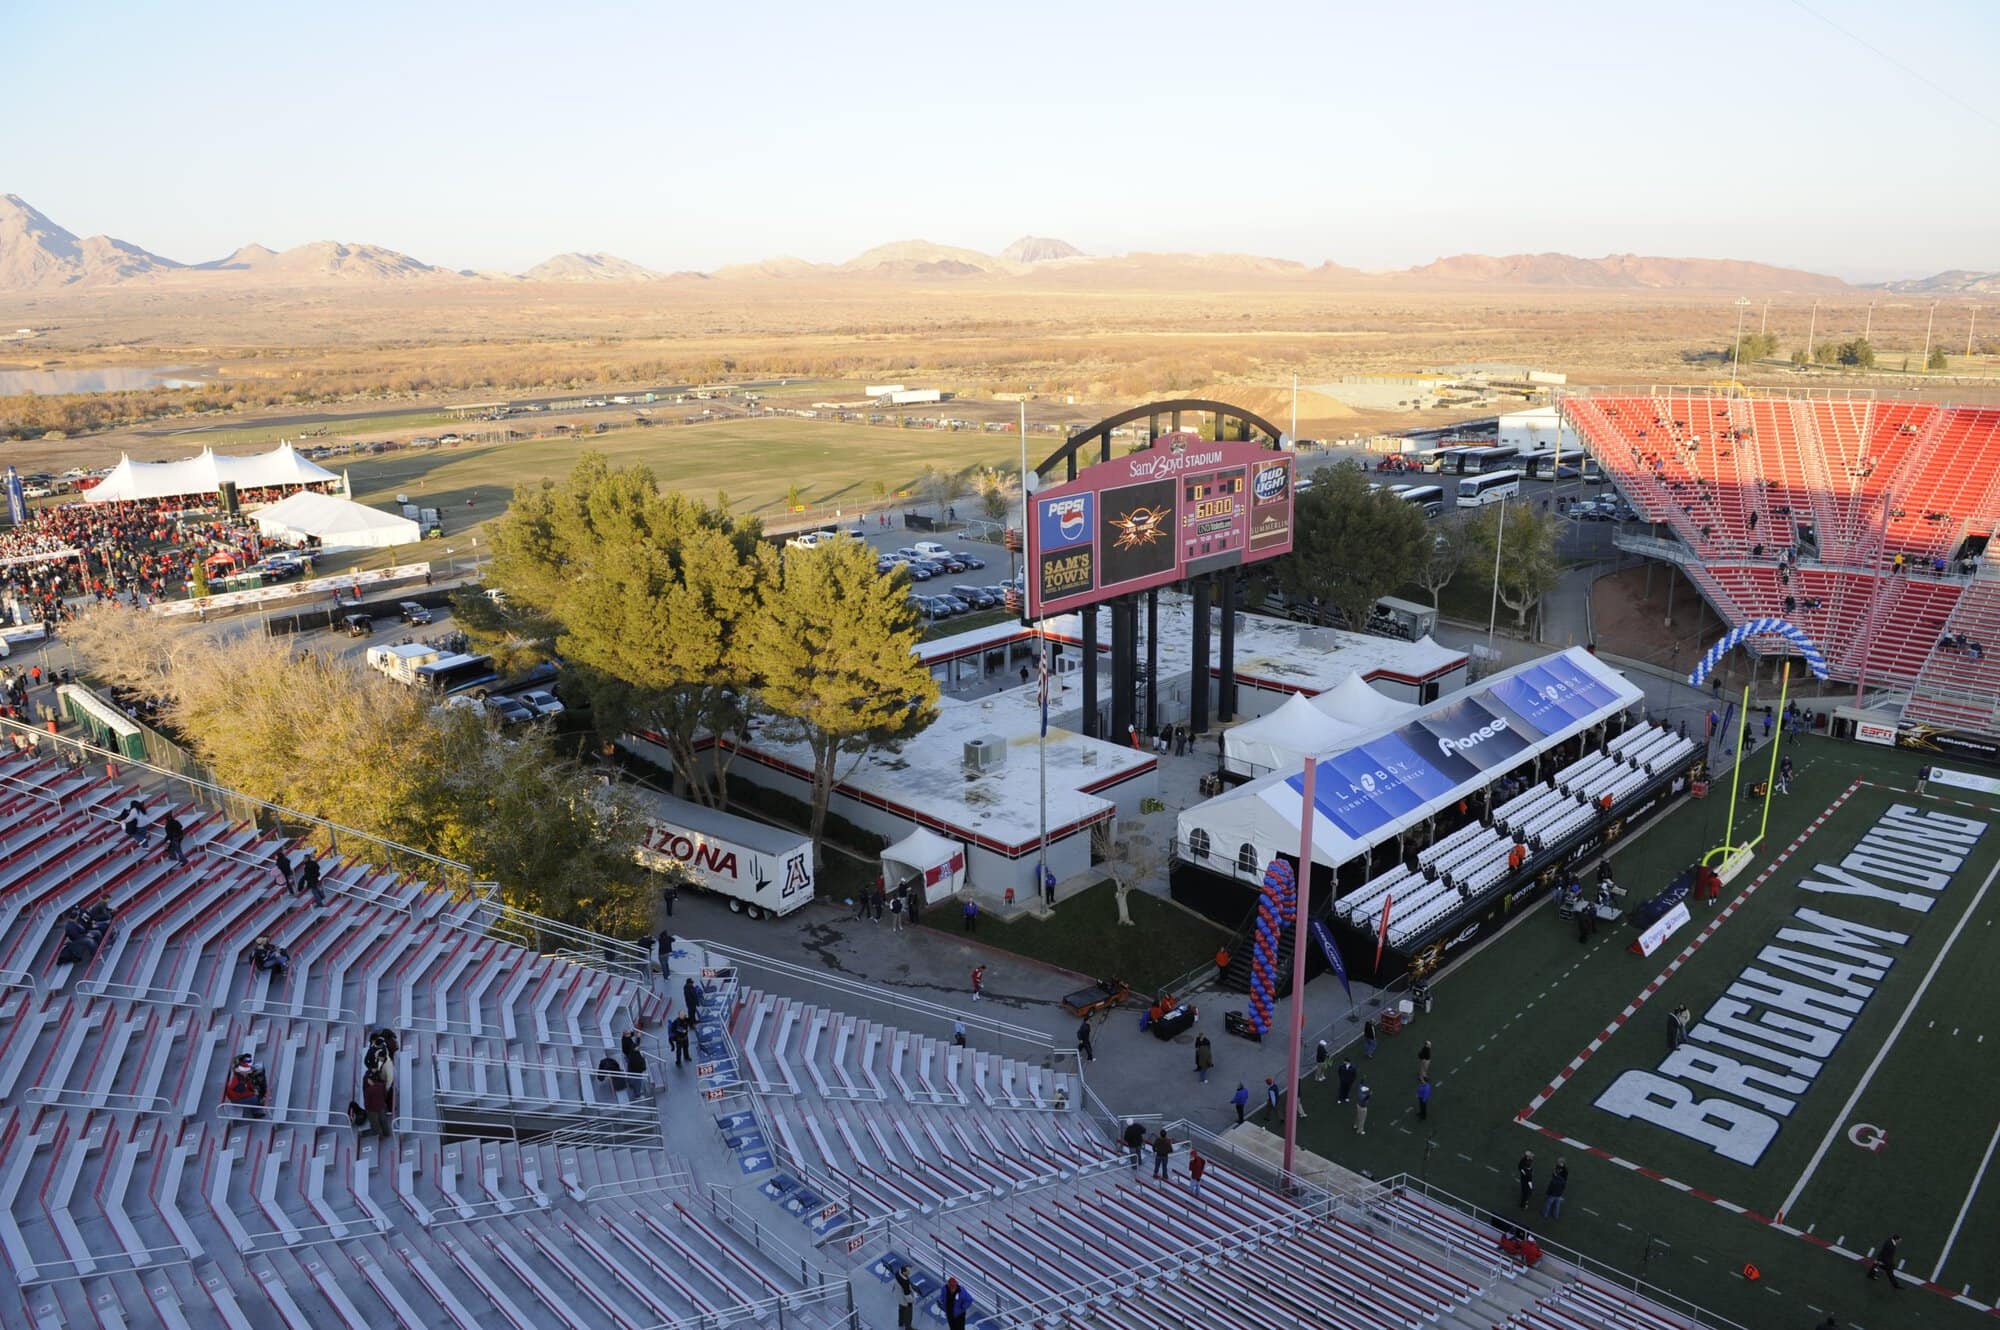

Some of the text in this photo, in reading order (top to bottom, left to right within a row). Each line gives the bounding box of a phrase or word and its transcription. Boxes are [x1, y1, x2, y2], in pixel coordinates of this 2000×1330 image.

[1129, 451, 1222, 479] Sam Boyd STADIUM
[1260, 467, 1283, 482] BUD
[1195, 485, 1203, 500] 0
[1234, 478, 1242, 493] 0
[1256, 475, 1286, 493] LIGHT
[1048, 498, 1085, 517] PEPSI
[1196, 498, 1232, 518] 60:00
[1250, 520, 1289, 536] SUMMERLIN
[1044, 552, 1090, 576] SAM'S
[1045, 566, 1092, 589] TOWN
[1438, 716, 1510, 757] Pioneer
[1861, 726, 1894, 738] ESPN
[1338, 787, 1384, 813] FURNITURE
[642, 826, 739, 880] IZONA
[1797, 803, 1990, 913] YOUNG
[782, 853, 811, 899] A
[1593, 907, 1912, 1168] BRIGHAM
[1848, 1123, 1887, 1151] G
